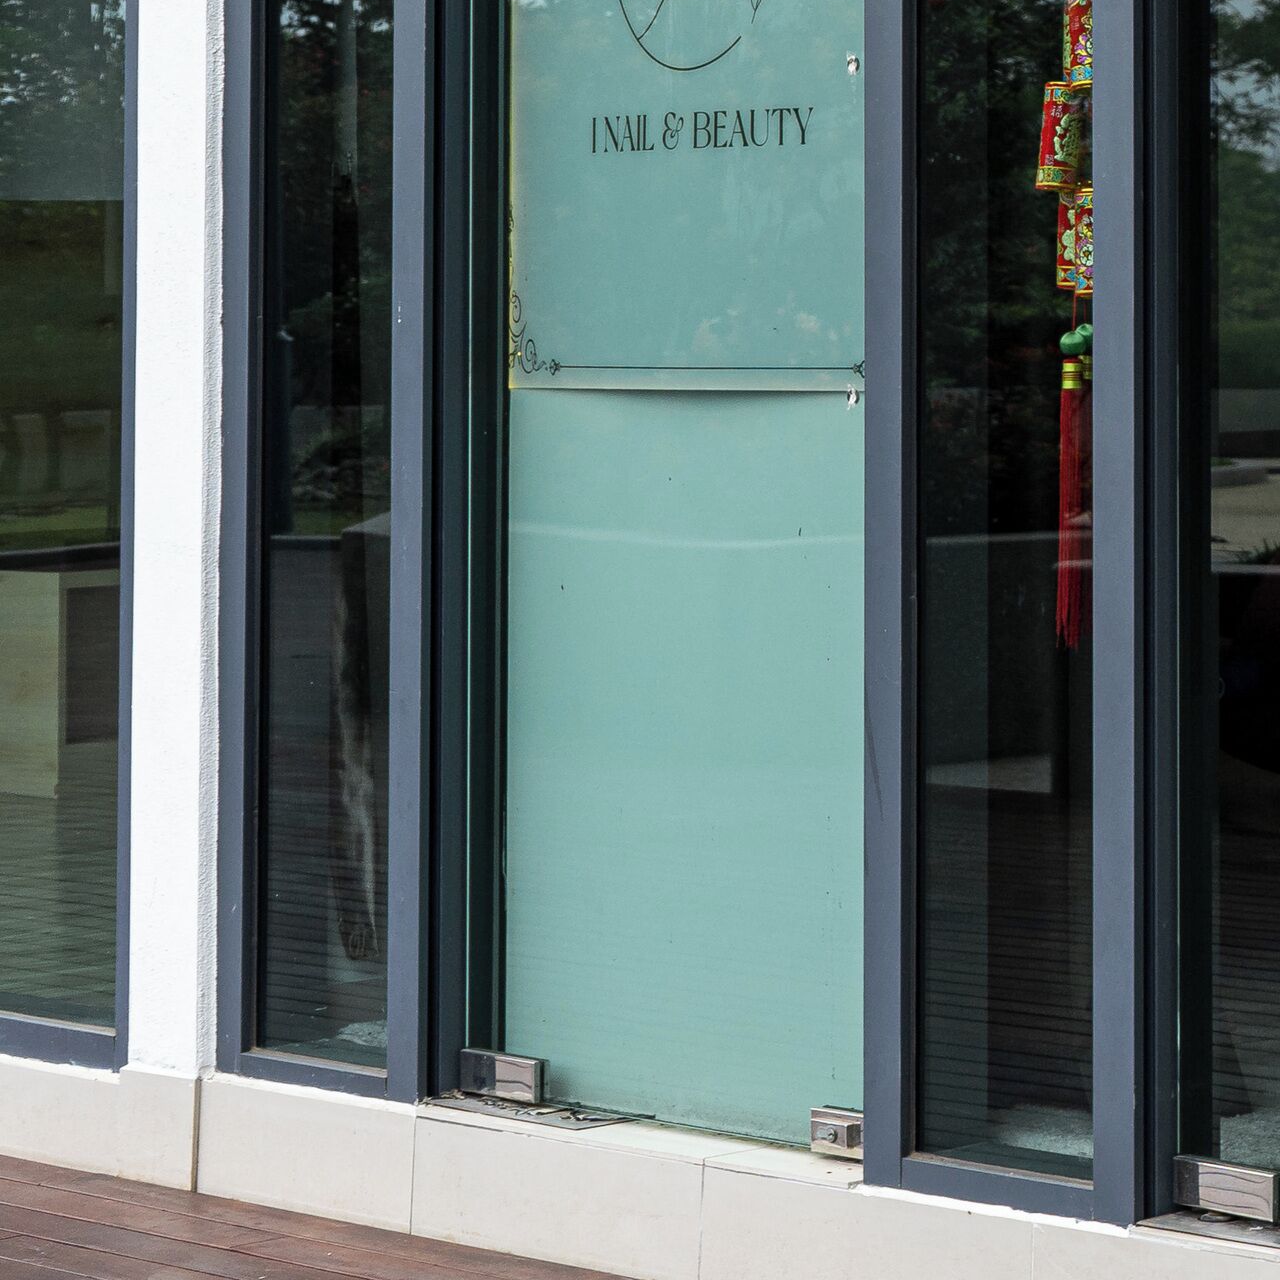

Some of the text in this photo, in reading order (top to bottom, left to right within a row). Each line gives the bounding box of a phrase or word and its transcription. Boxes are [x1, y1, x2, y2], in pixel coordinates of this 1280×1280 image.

[592, 107, 814, 153] I NAIL & BEAUTY
